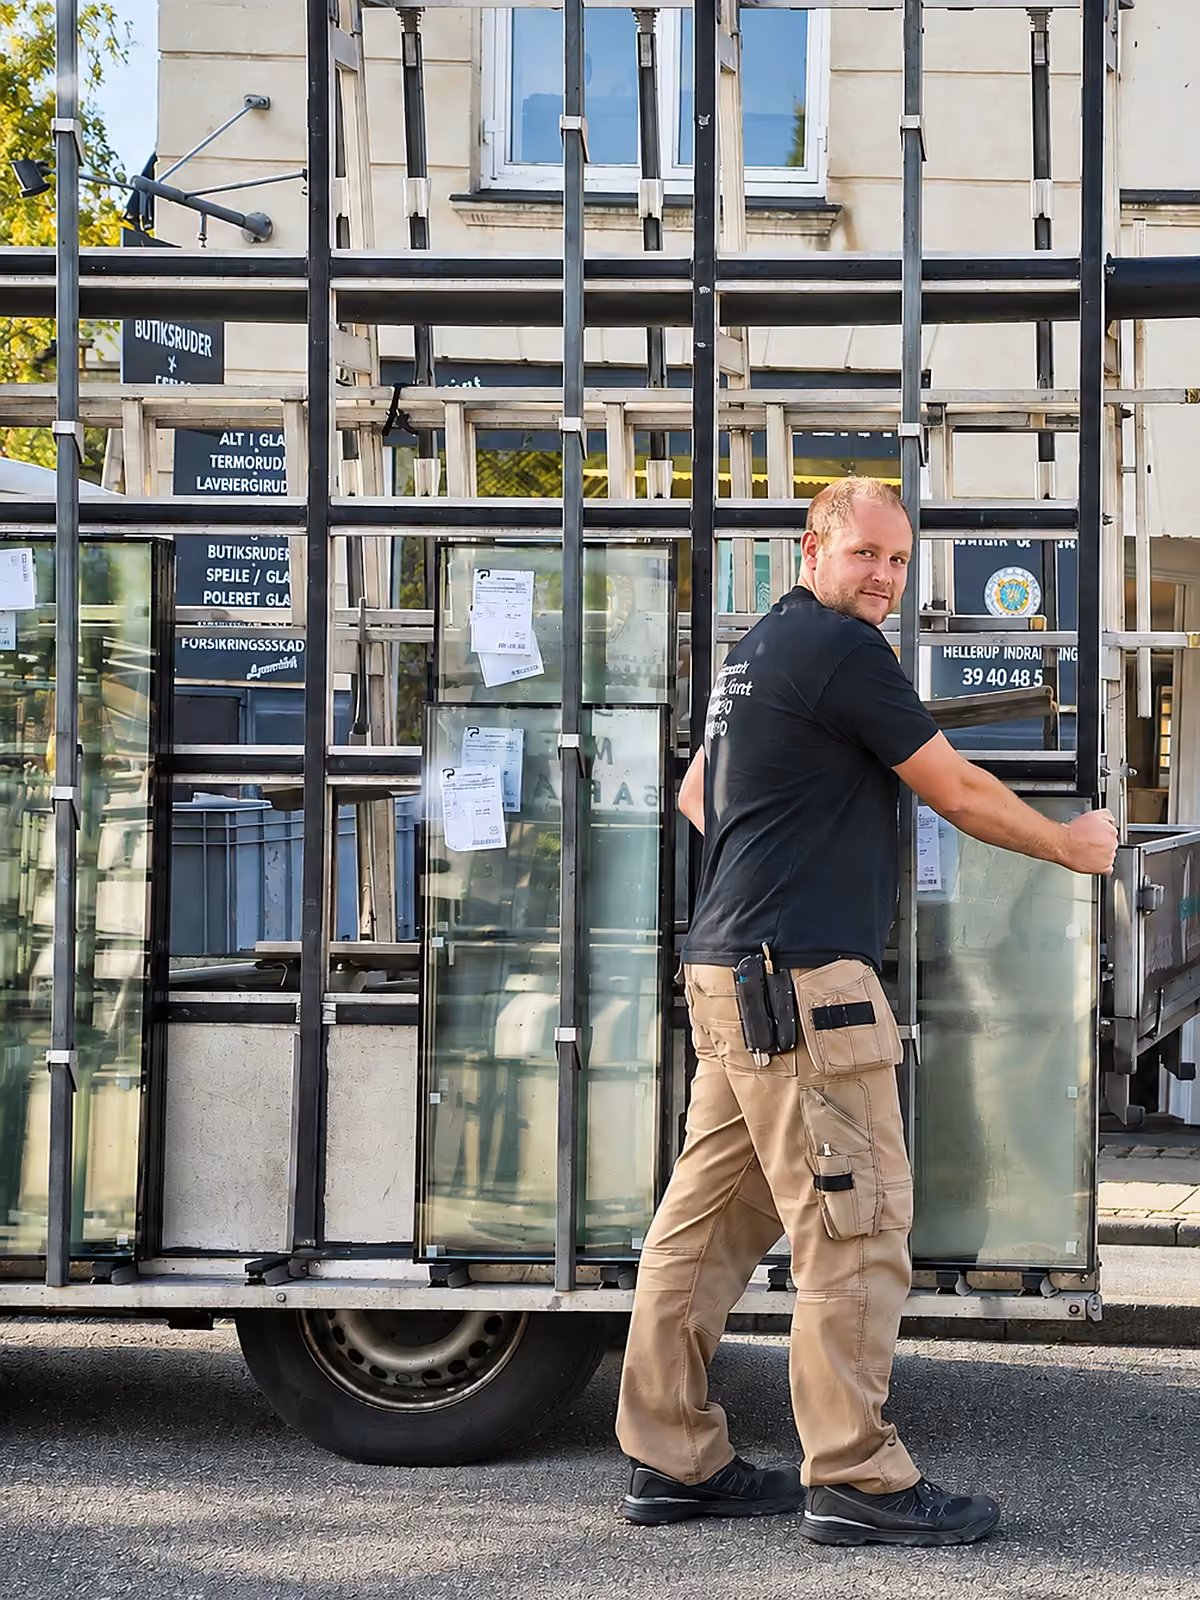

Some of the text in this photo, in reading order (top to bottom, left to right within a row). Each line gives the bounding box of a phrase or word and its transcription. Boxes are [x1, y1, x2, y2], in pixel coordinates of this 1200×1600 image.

[134, 319, 212, 357] BUTIKSRUDER
[219, 432, 245, 447] ALT
[249, 433, 254, 447] I
[209, 454, 287, 471] TERMORUD
[206, 568, 250, 583] SPEJLE
[203, 591, 260, 605] POLERET
[943, 646, 1000, 659] HELLERUP
[962, 668, 983, 686] 39
[986, 668, 1007, 687] 40
[1009, 668, 1031, 688] 48
